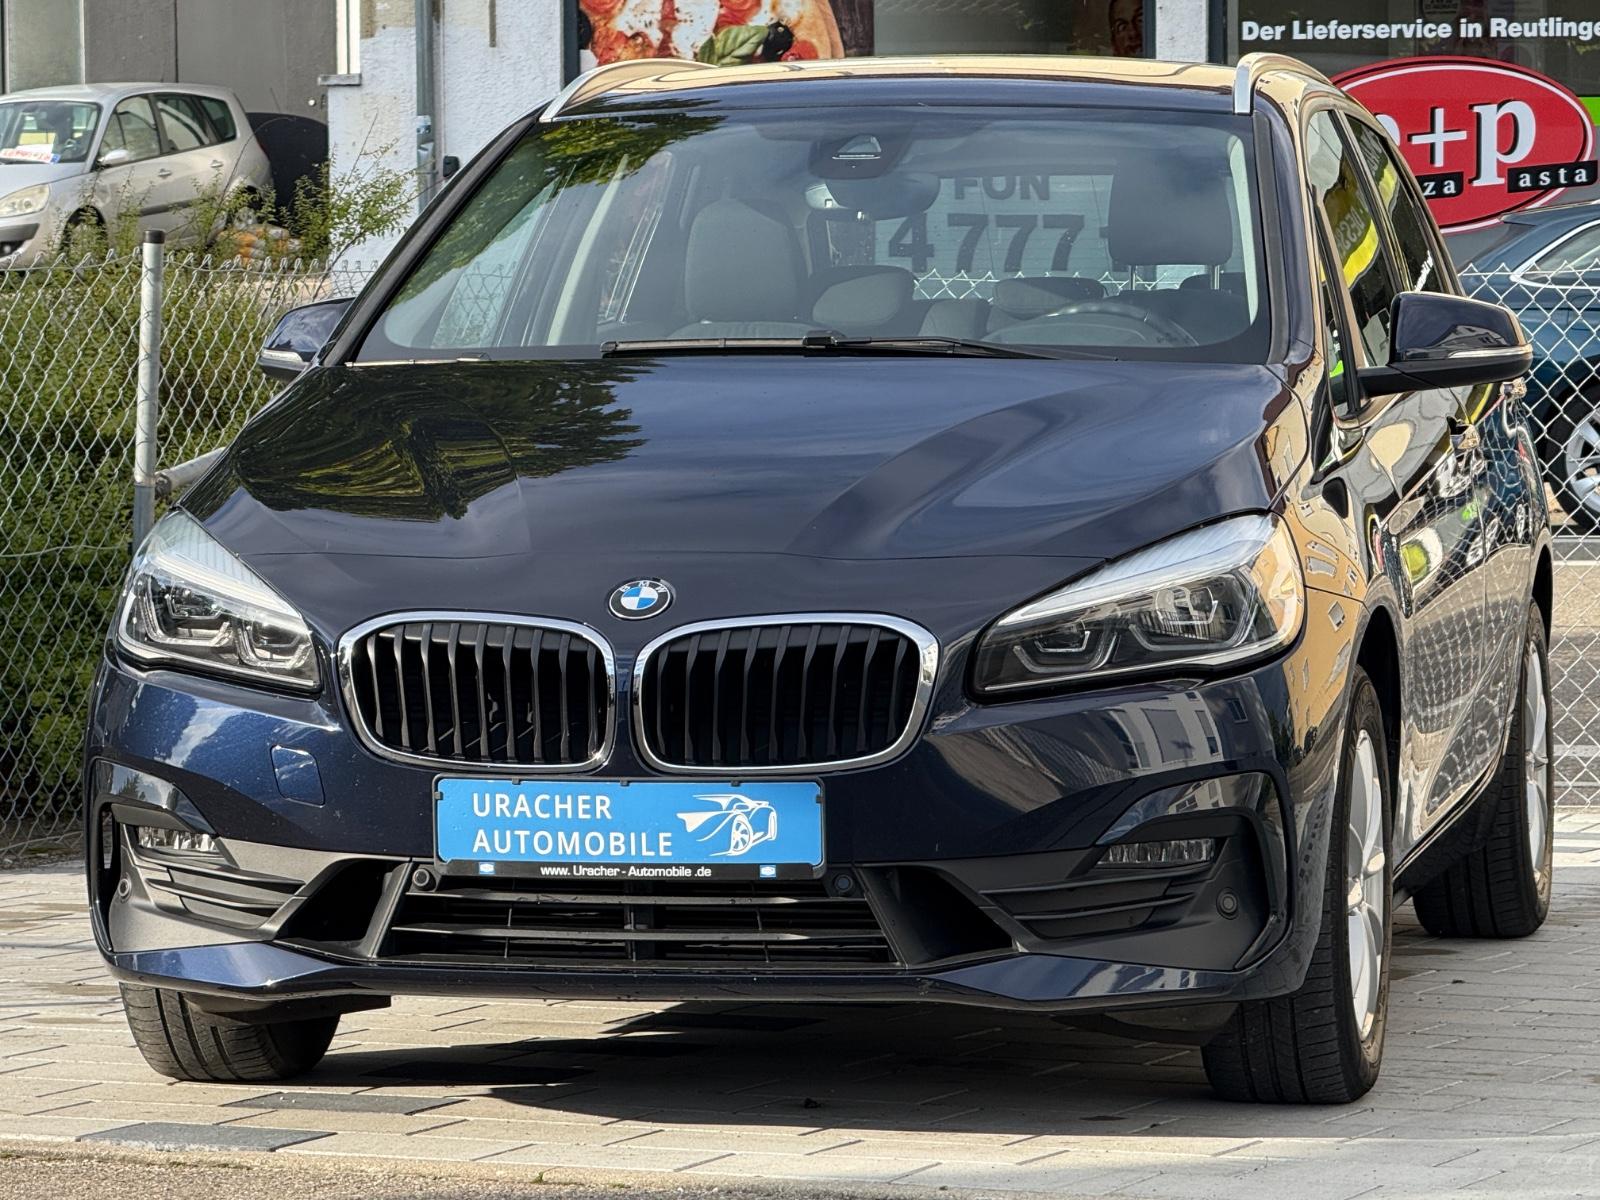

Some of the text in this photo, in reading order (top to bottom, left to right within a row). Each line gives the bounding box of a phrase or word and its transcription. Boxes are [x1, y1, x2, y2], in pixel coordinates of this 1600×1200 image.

[1241, 21, 1286, 41] Der
[1292, 18, 1452, 40] Lieferservice
[1460, 18, 1483, 39] in
[1518, 168, 1588, 188] asta
[472, 792, 613, 820] URACHER
[472, 828, 673, 857] AUTOMOBILE
